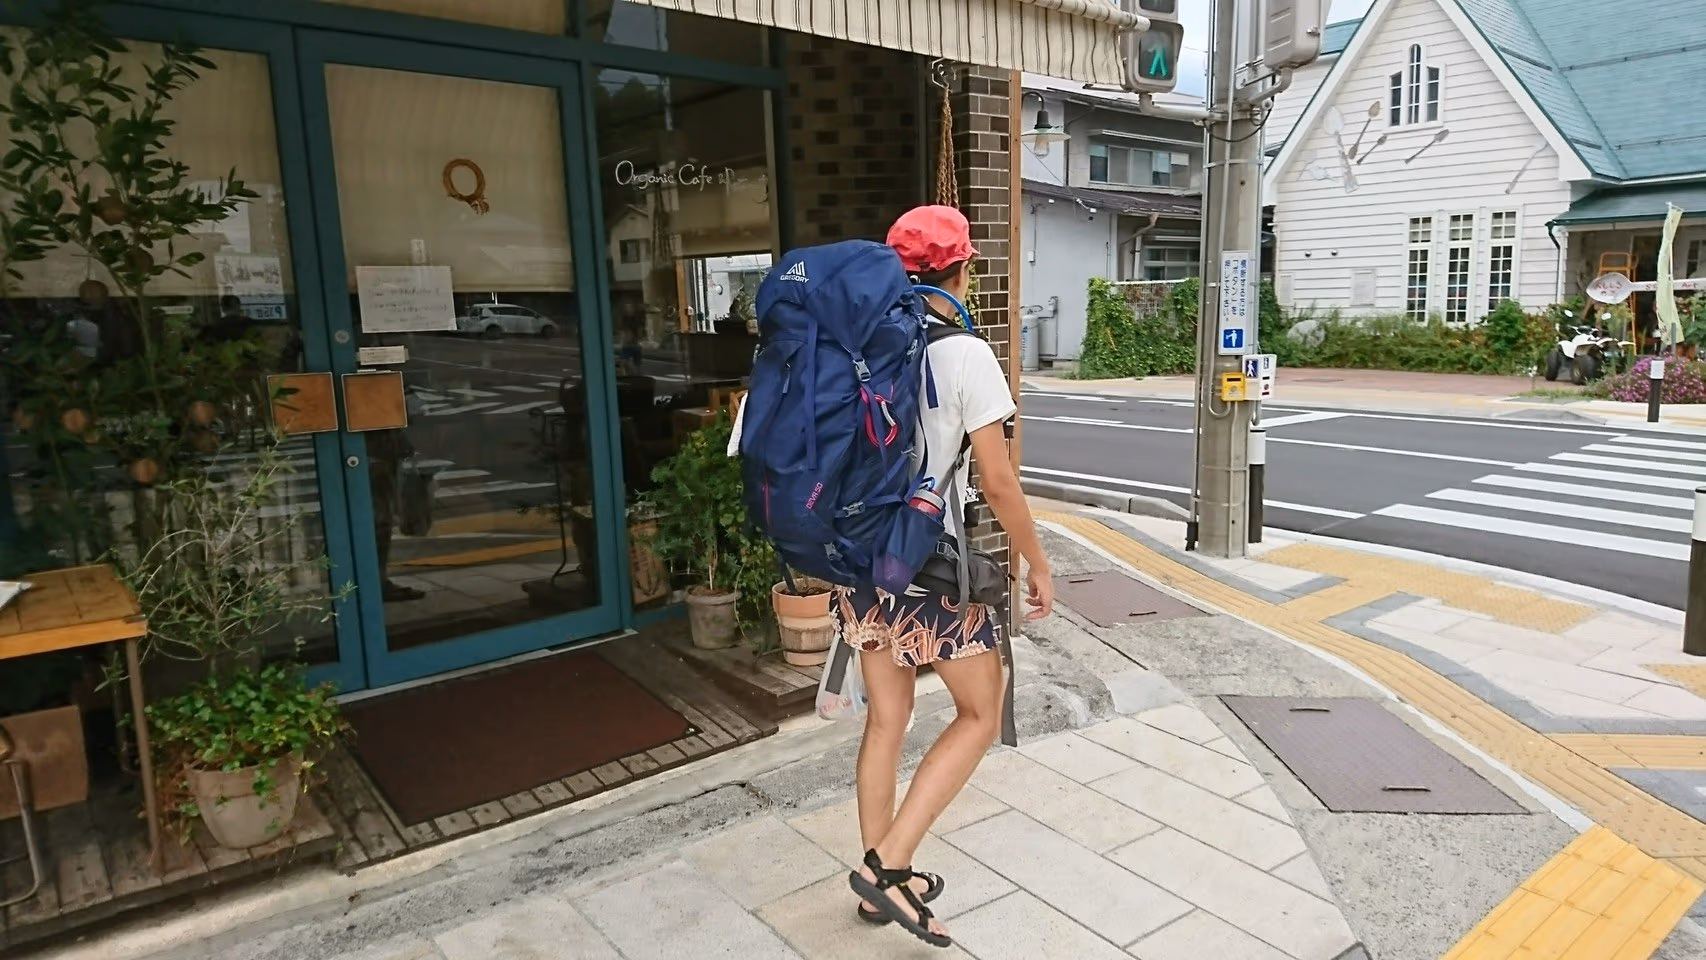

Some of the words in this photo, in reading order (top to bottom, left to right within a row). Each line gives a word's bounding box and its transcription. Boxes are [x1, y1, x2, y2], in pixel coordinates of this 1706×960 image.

[615, 160, 675, 190] Organic
[678, 163, 713, 192] Cafe
[780, 274, 809, 283] GREGORY
[806, 491, 818, 509] DEVA
[815, 482, 823, 493] 50
